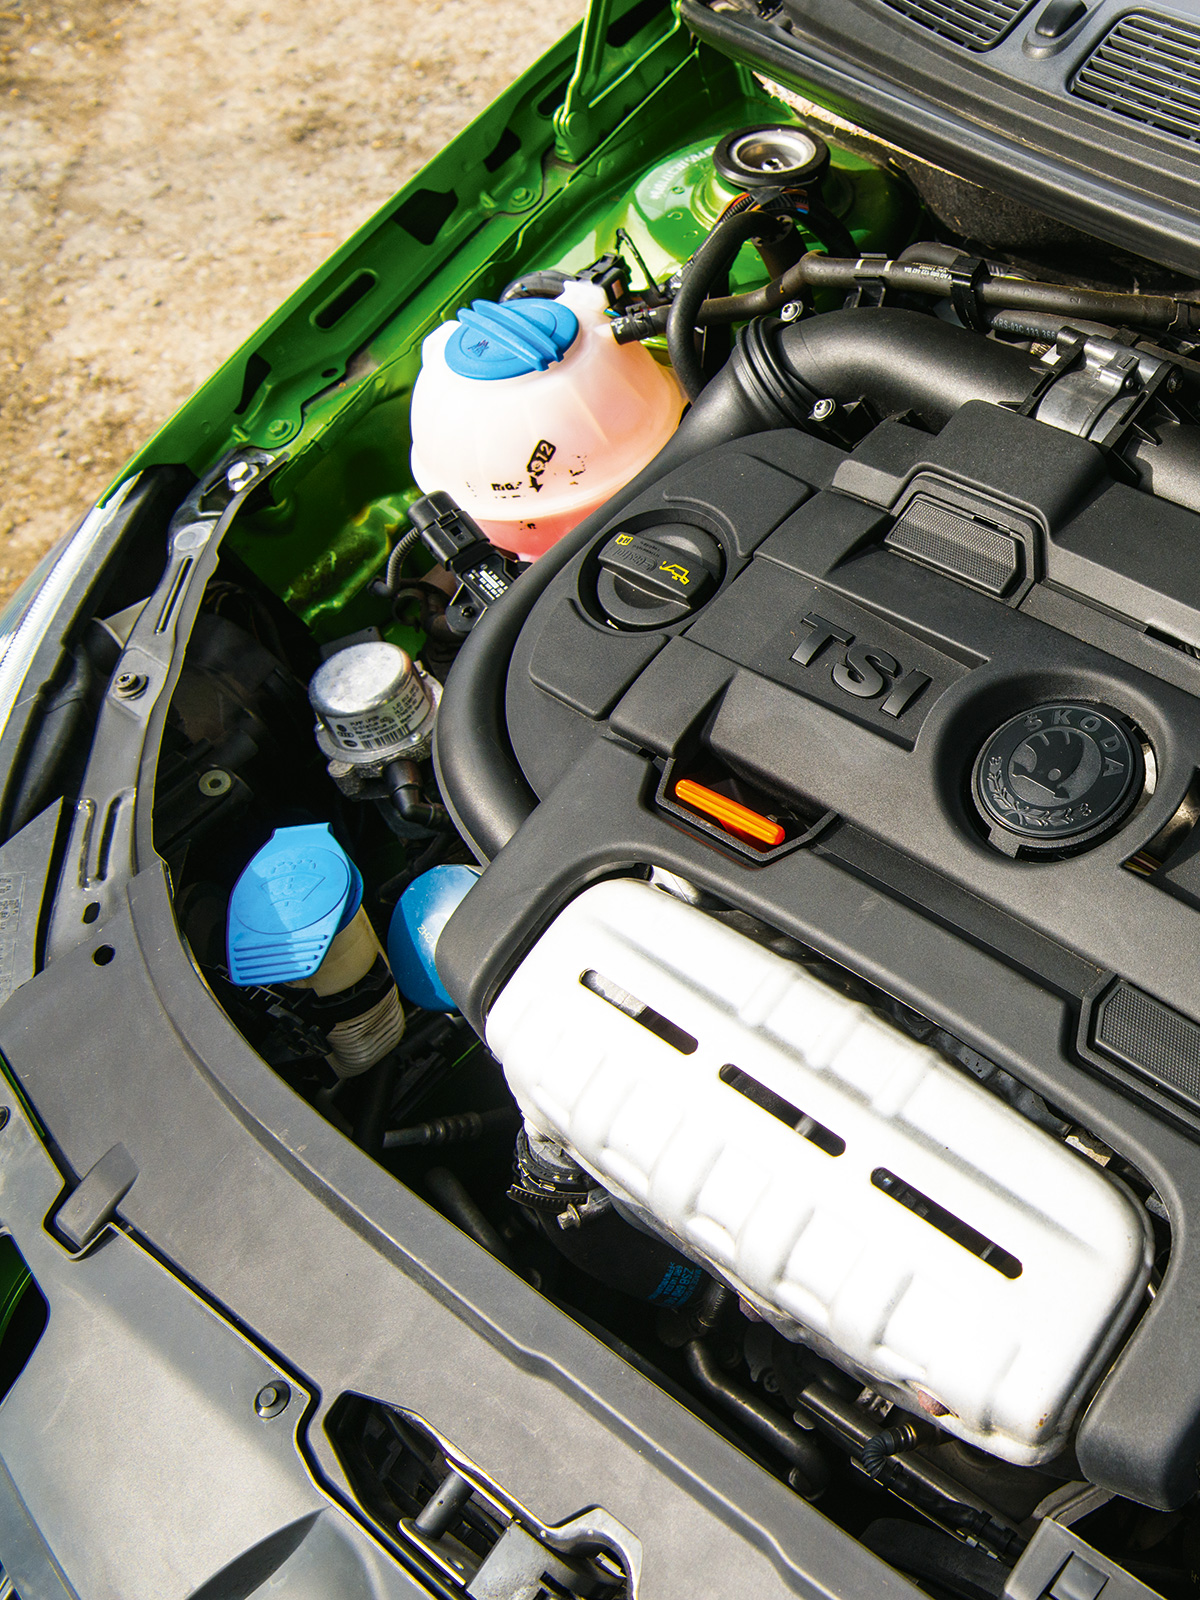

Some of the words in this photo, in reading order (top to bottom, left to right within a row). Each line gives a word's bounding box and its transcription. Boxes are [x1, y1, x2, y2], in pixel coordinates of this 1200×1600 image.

[788, 612, 934, 719] TSI
[1024, 709, 1124, 778] ŠKODA
[678, 1266, 694, 1285] ZSB
